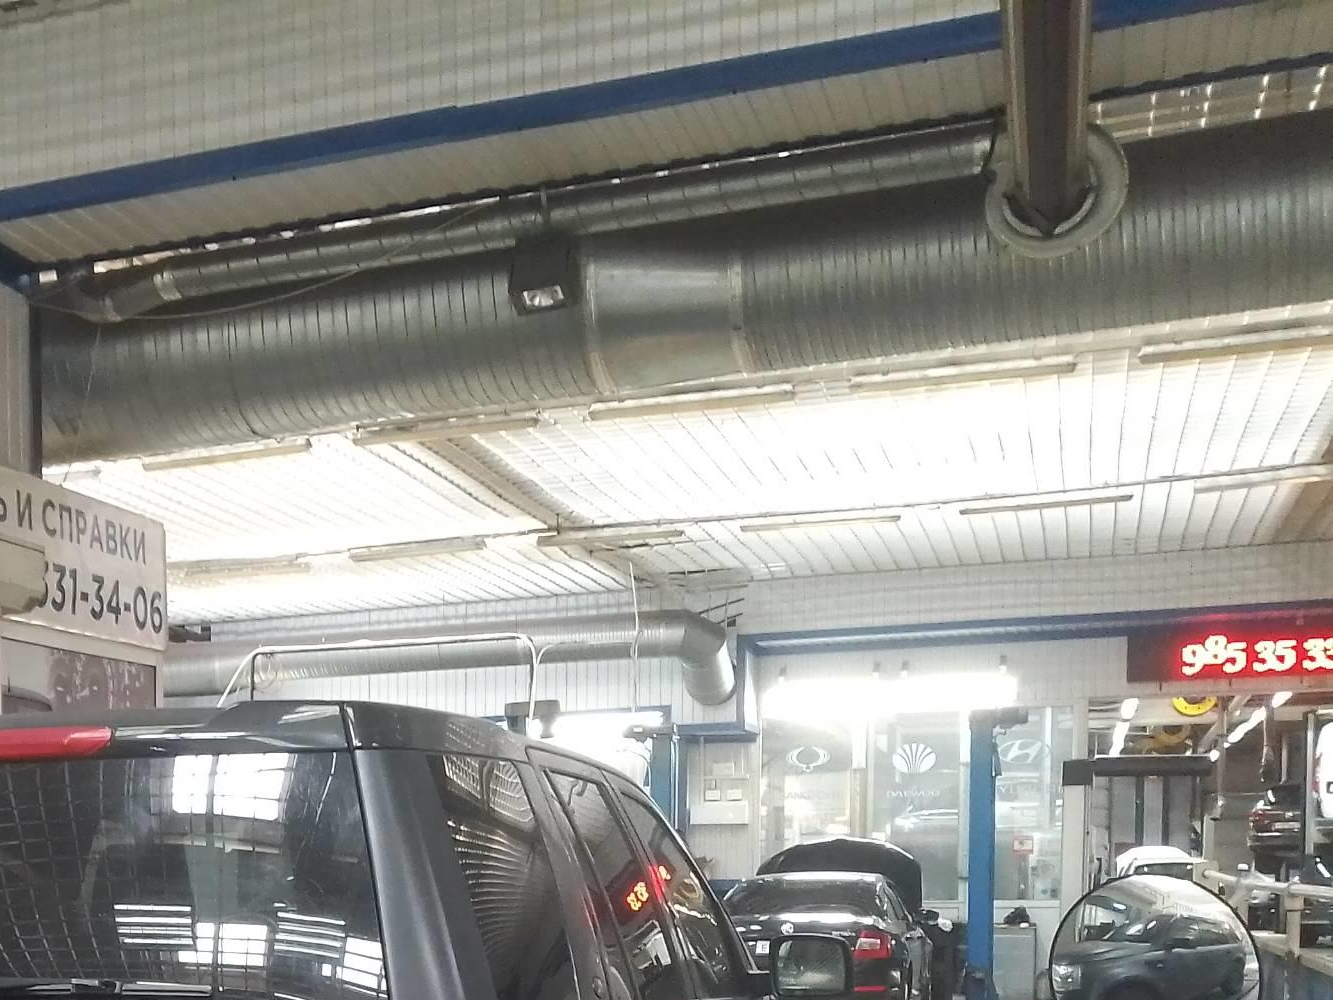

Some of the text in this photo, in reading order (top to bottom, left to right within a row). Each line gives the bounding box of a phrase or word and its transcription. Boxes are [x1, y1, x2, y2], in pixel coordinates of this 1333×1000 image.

[16, 489, 34, 531] И
[41, 498, 147, 565] СПРАВКИ
[1181, 634, 1248, 677] 985
[1252, 639, 1298, 673] 35
